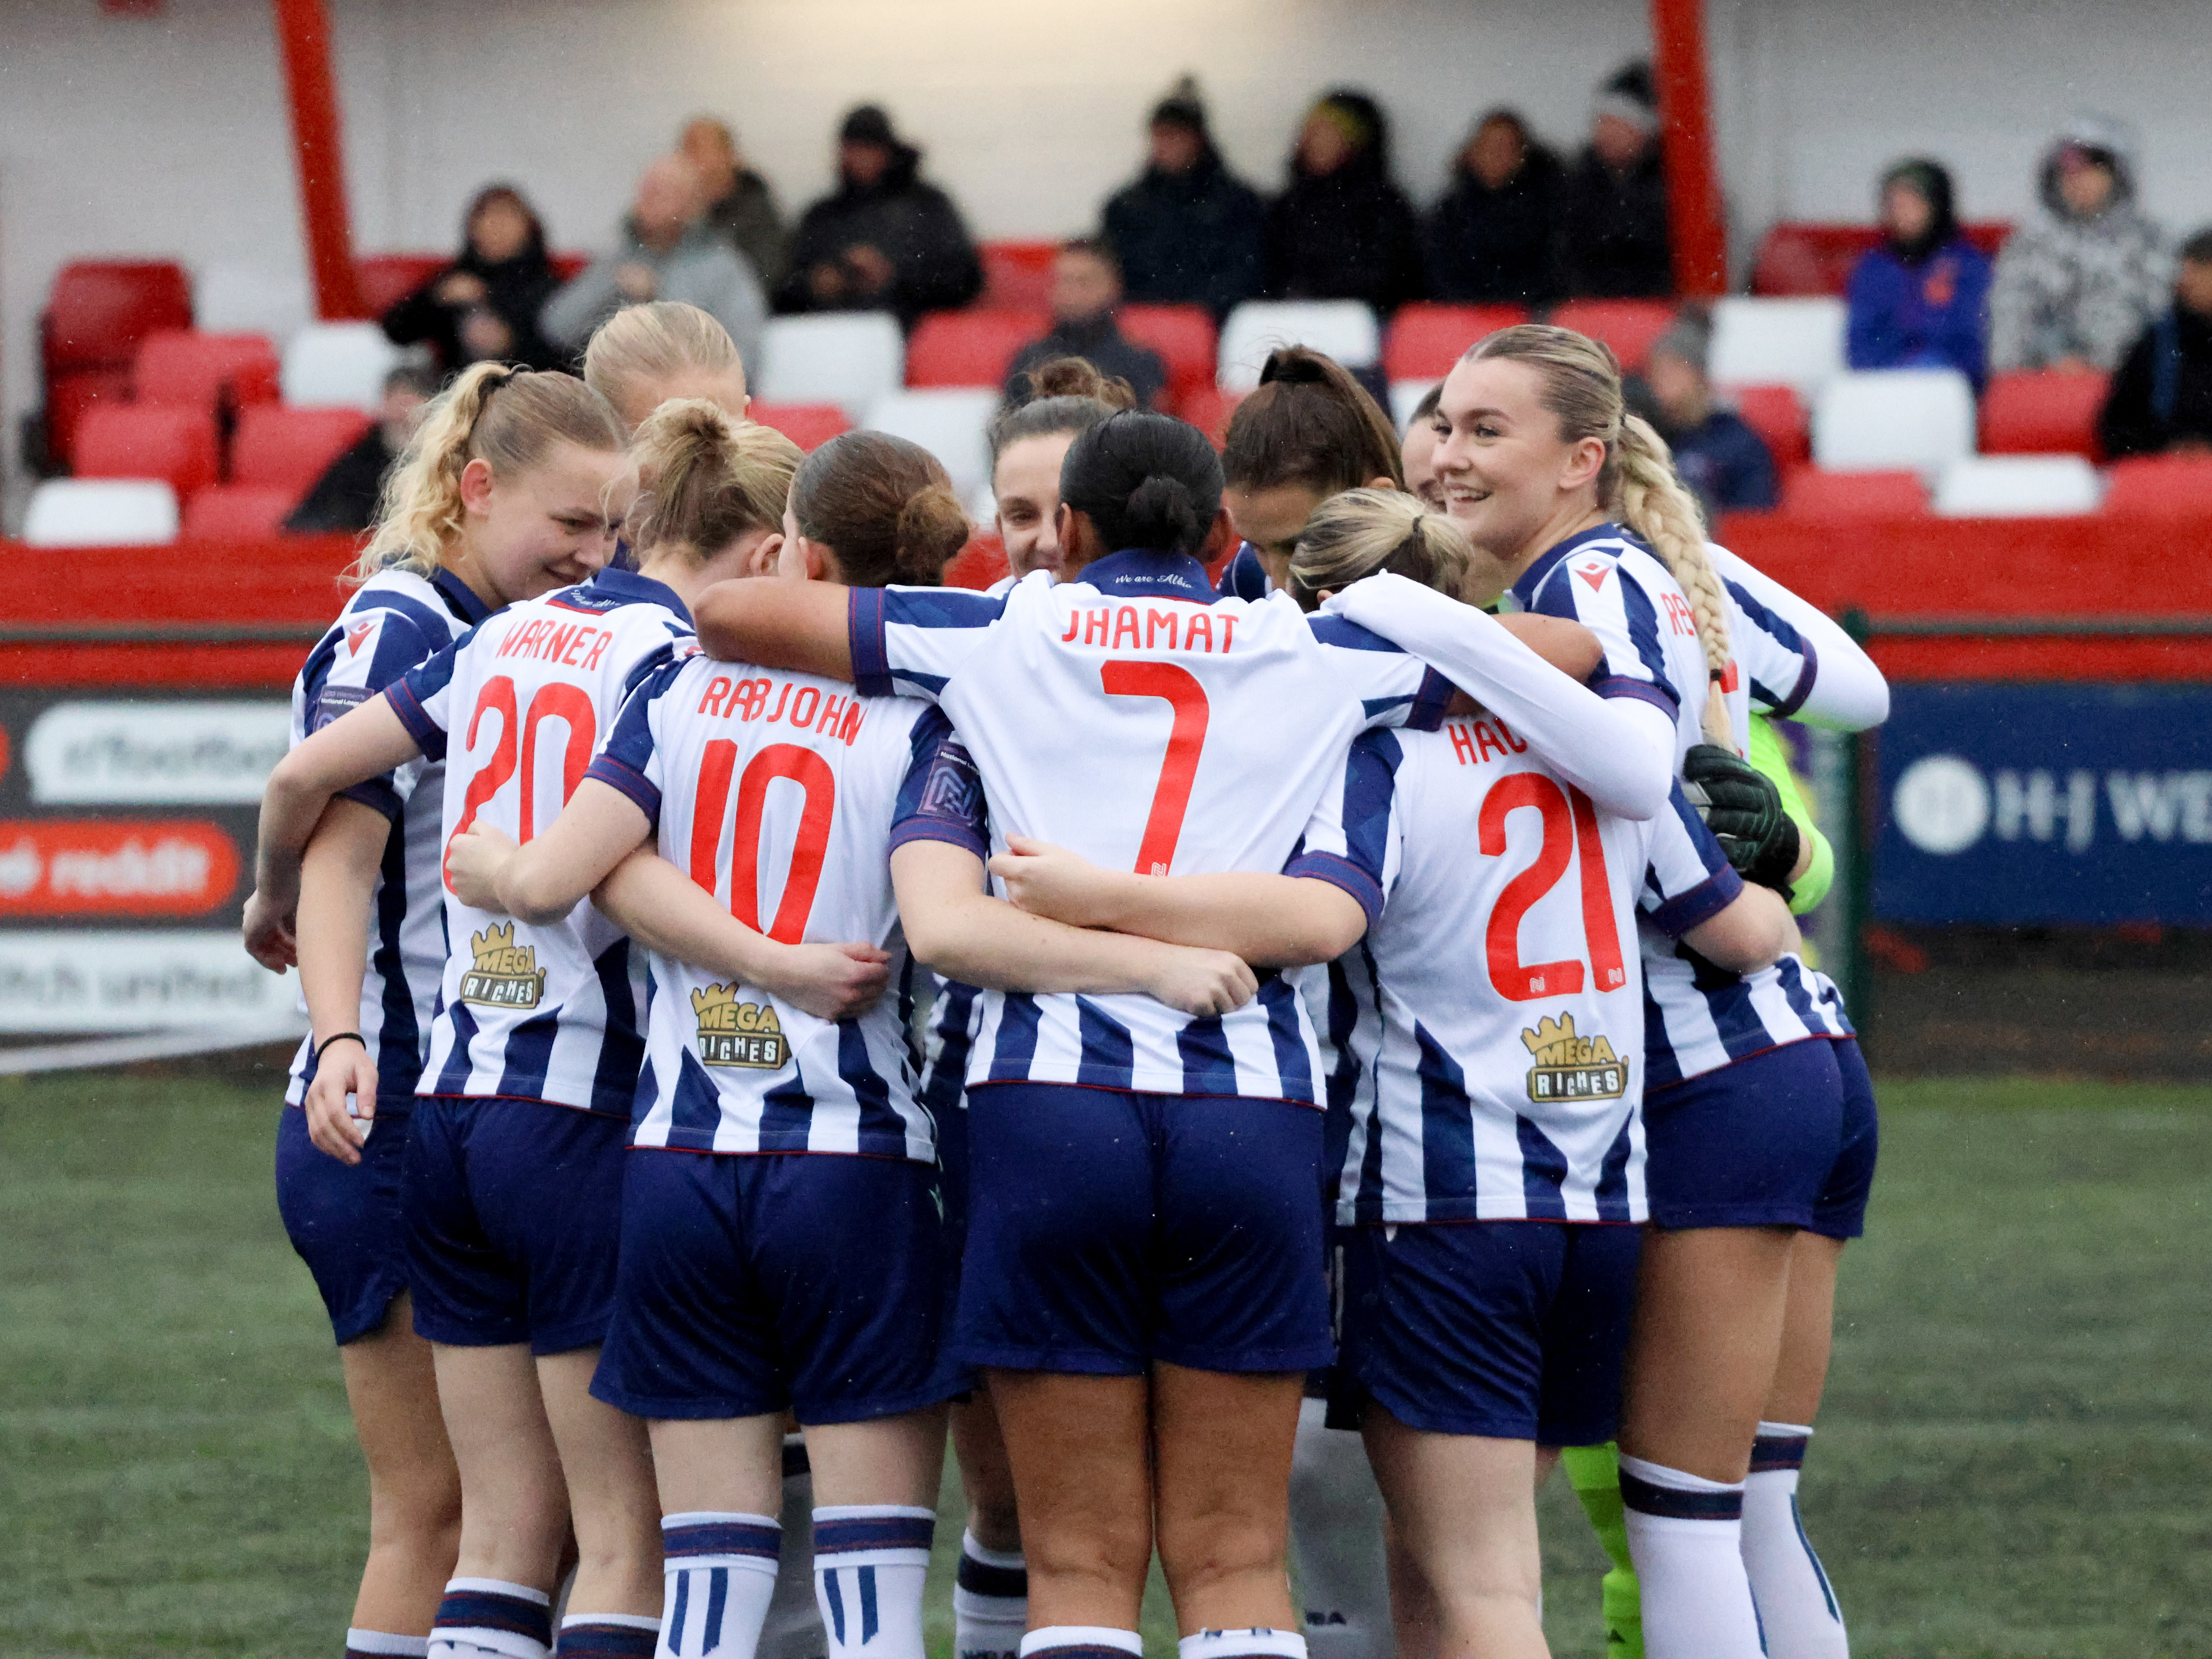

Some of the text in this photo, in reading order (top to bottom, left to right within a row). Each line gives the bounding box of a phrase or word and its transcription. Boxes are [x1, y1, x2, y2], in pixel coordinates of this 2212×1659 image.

[1115, 574, 1133, 584] We
[495, 619, 613, 670] WARNER
[1062, 605, 1239, 654] JHAMAT
[698, 676, 868, 746] RABJOHN
[940, 751, 967, 766] National
[1100, 660, 1210, 876] 7
[443, 675, 596, 895] 20
[690, 739, 835, 945] 10
[1478, 772, 1626, 1002] 21
[473, 945, 536, 974] MEGA
[464, 978, 533, 1003] RICHES
[699, 1001, 780, 1033] MEGA
[699, 1036, 777, 1062] RICHES
[1536, 1035, 1617, 1066] MEGA
[1537, 1070, 1618, 1095] RICHES
